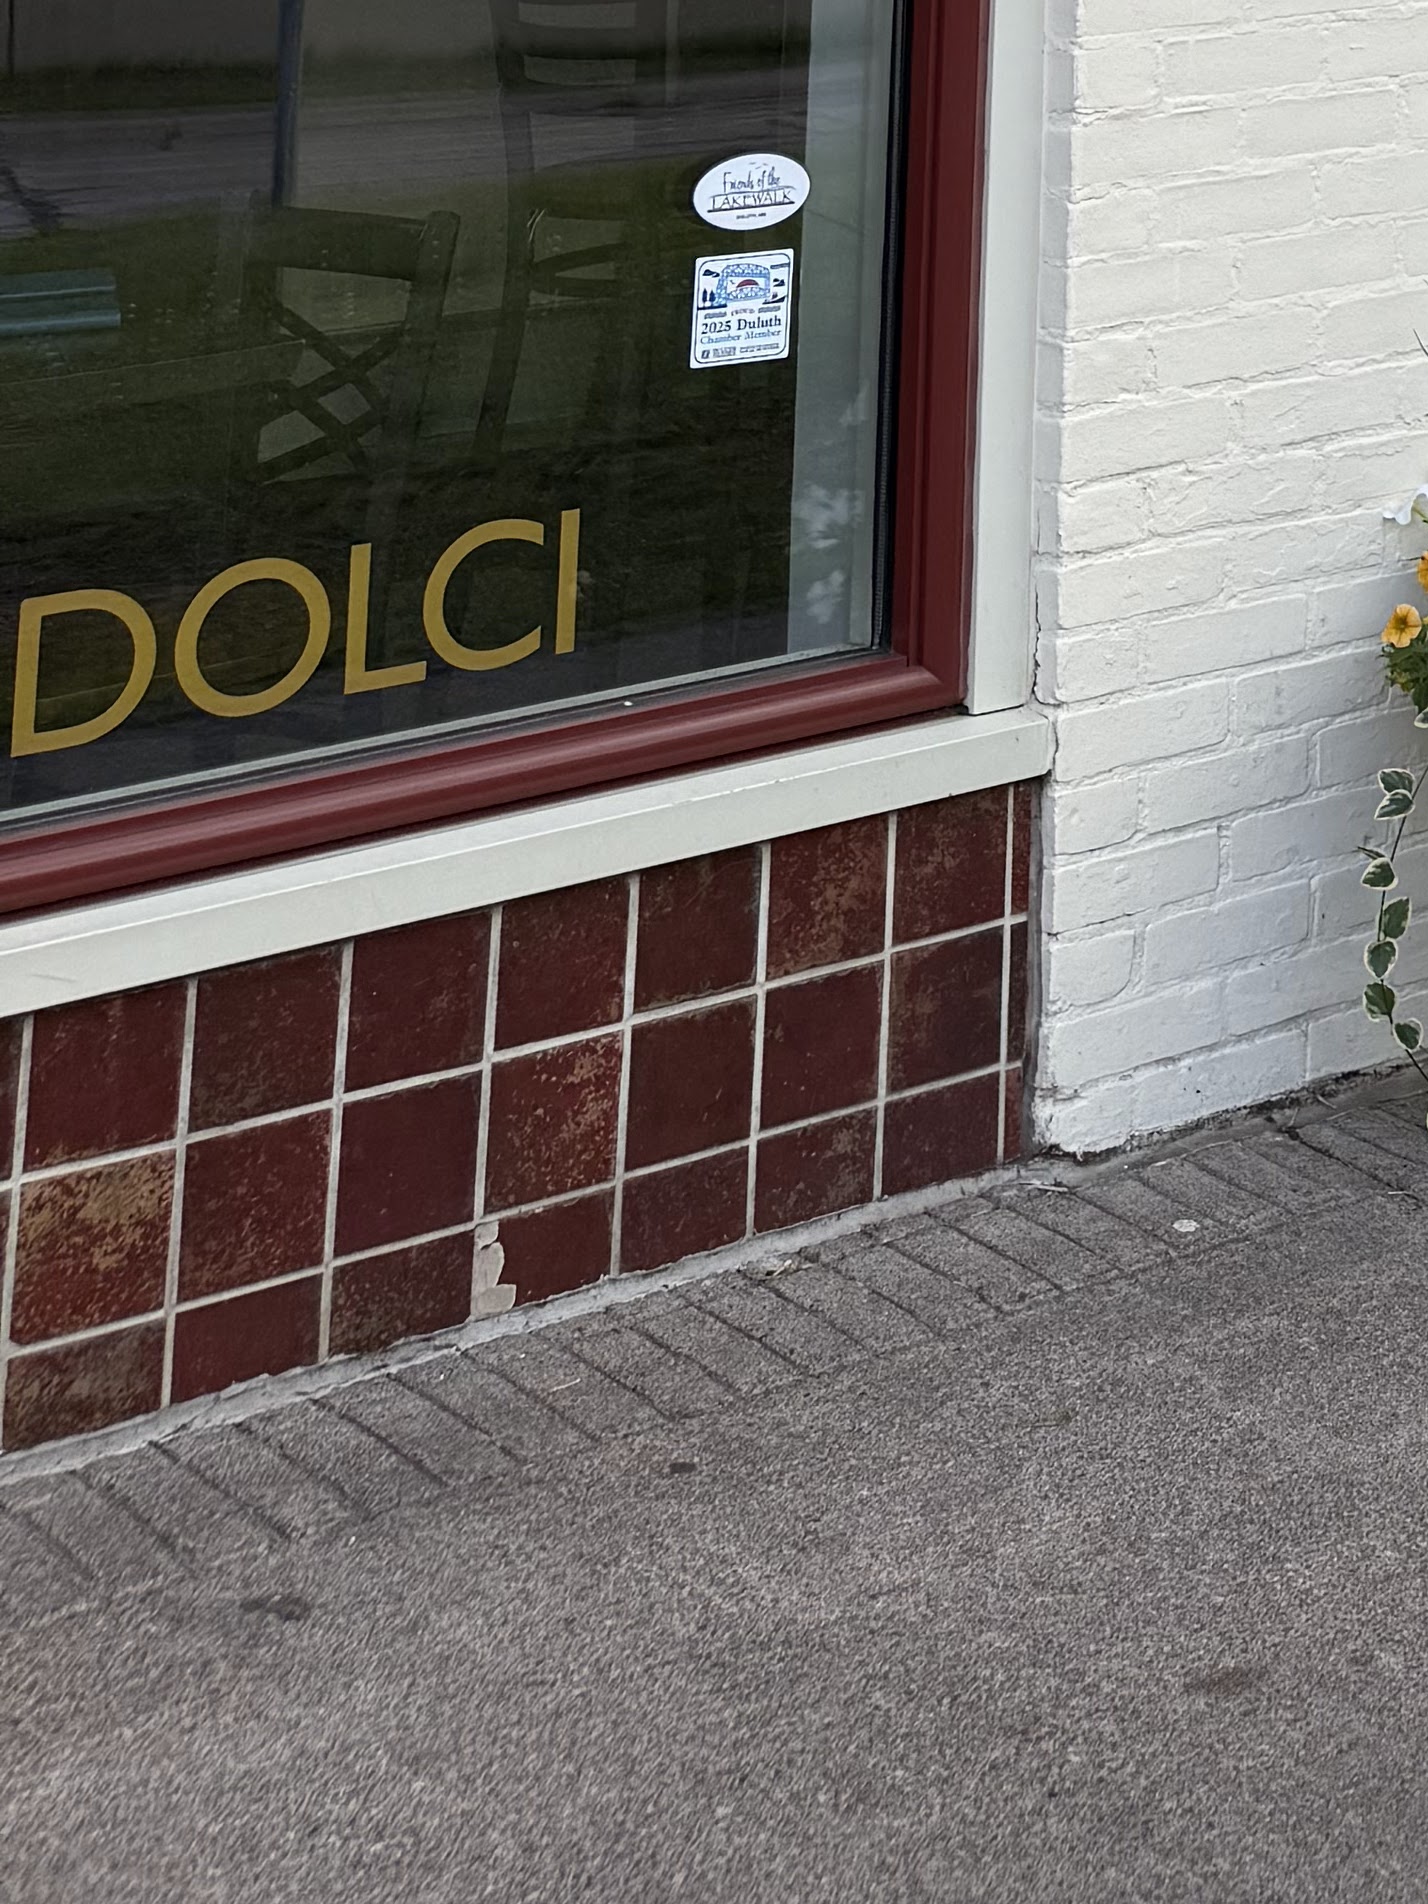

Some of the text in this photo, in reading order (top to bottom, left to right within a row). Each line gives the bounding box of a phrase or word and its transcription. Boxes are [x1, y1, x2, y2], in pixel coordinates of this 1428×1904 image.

[701, 319, 732, 334] 2025
[737, 314, 782, 330] Duluth
[700, 328, 782, 345] Chamber Member
[11, 508, 581, 759] DOLCI
